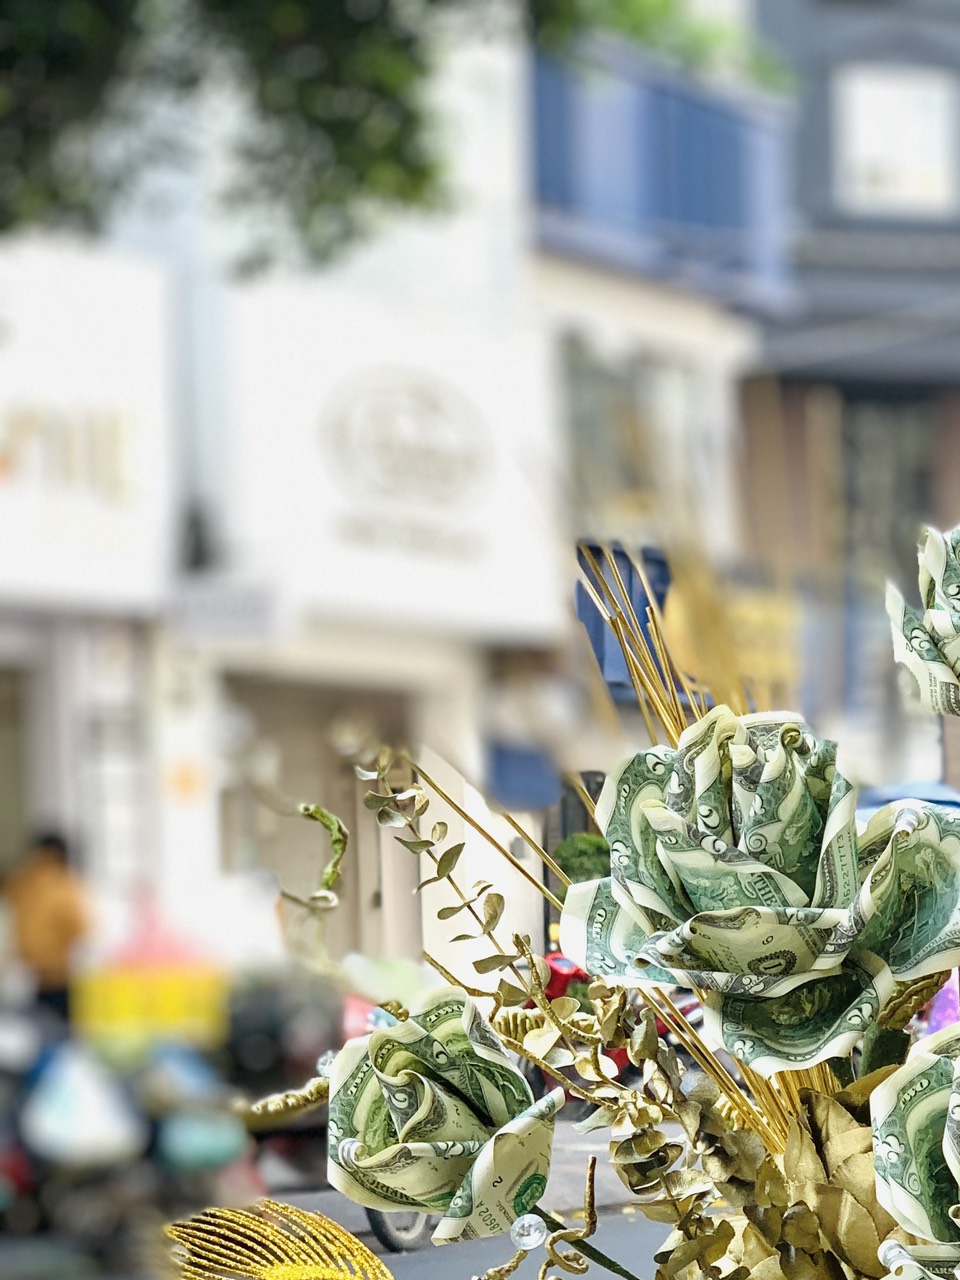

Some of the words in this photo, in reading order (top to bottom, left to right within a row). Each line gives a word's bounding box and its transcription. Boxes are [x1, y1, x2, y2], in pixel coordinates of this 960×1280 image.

[427, 1004, 465, 1024] TWO
[348, 1060, 372, 1096] TWO
[901, 1078, 931, 1108] TWO
[492, 1175, 504, 1188] 2
